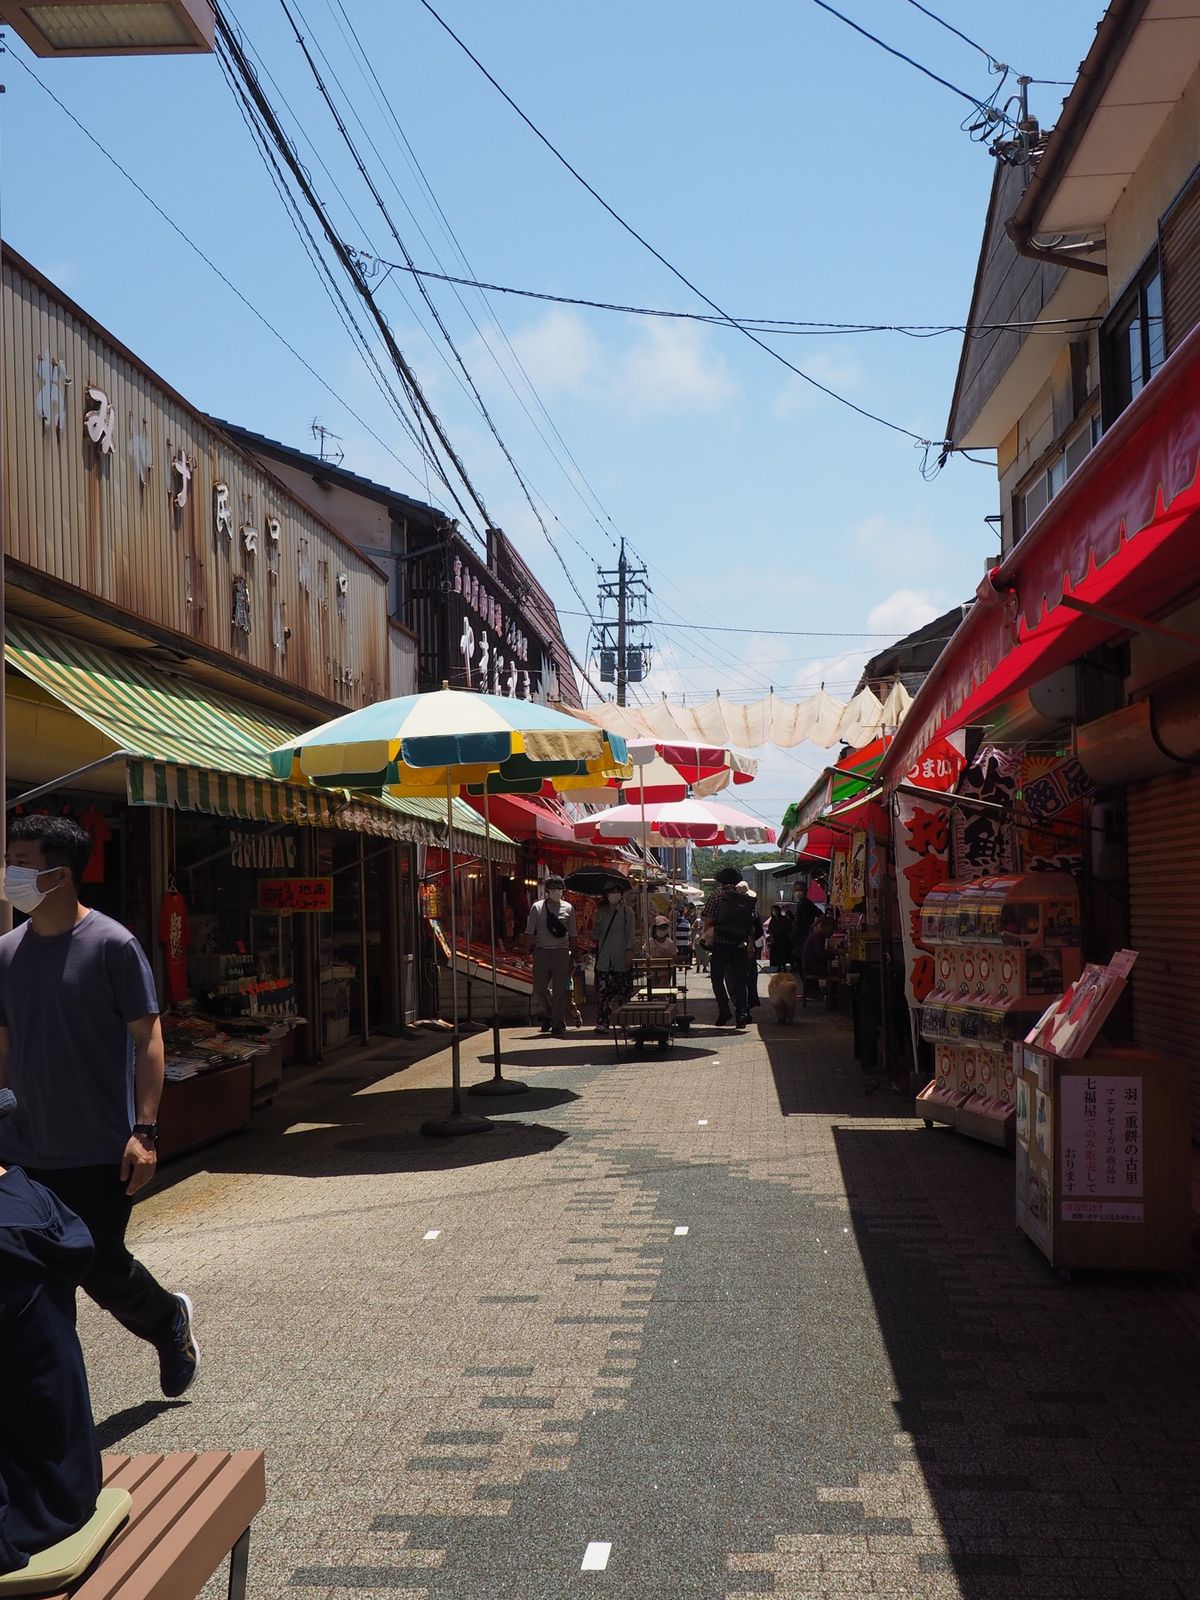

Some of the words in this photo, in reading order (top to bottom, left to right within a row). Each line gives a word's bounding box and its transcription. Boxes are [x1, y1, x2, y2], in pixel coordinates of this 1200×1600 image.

[1065, 1148, 1077, 1193] おります
[1124, 1088, 1138, 1184] 羽二重餅の古里
